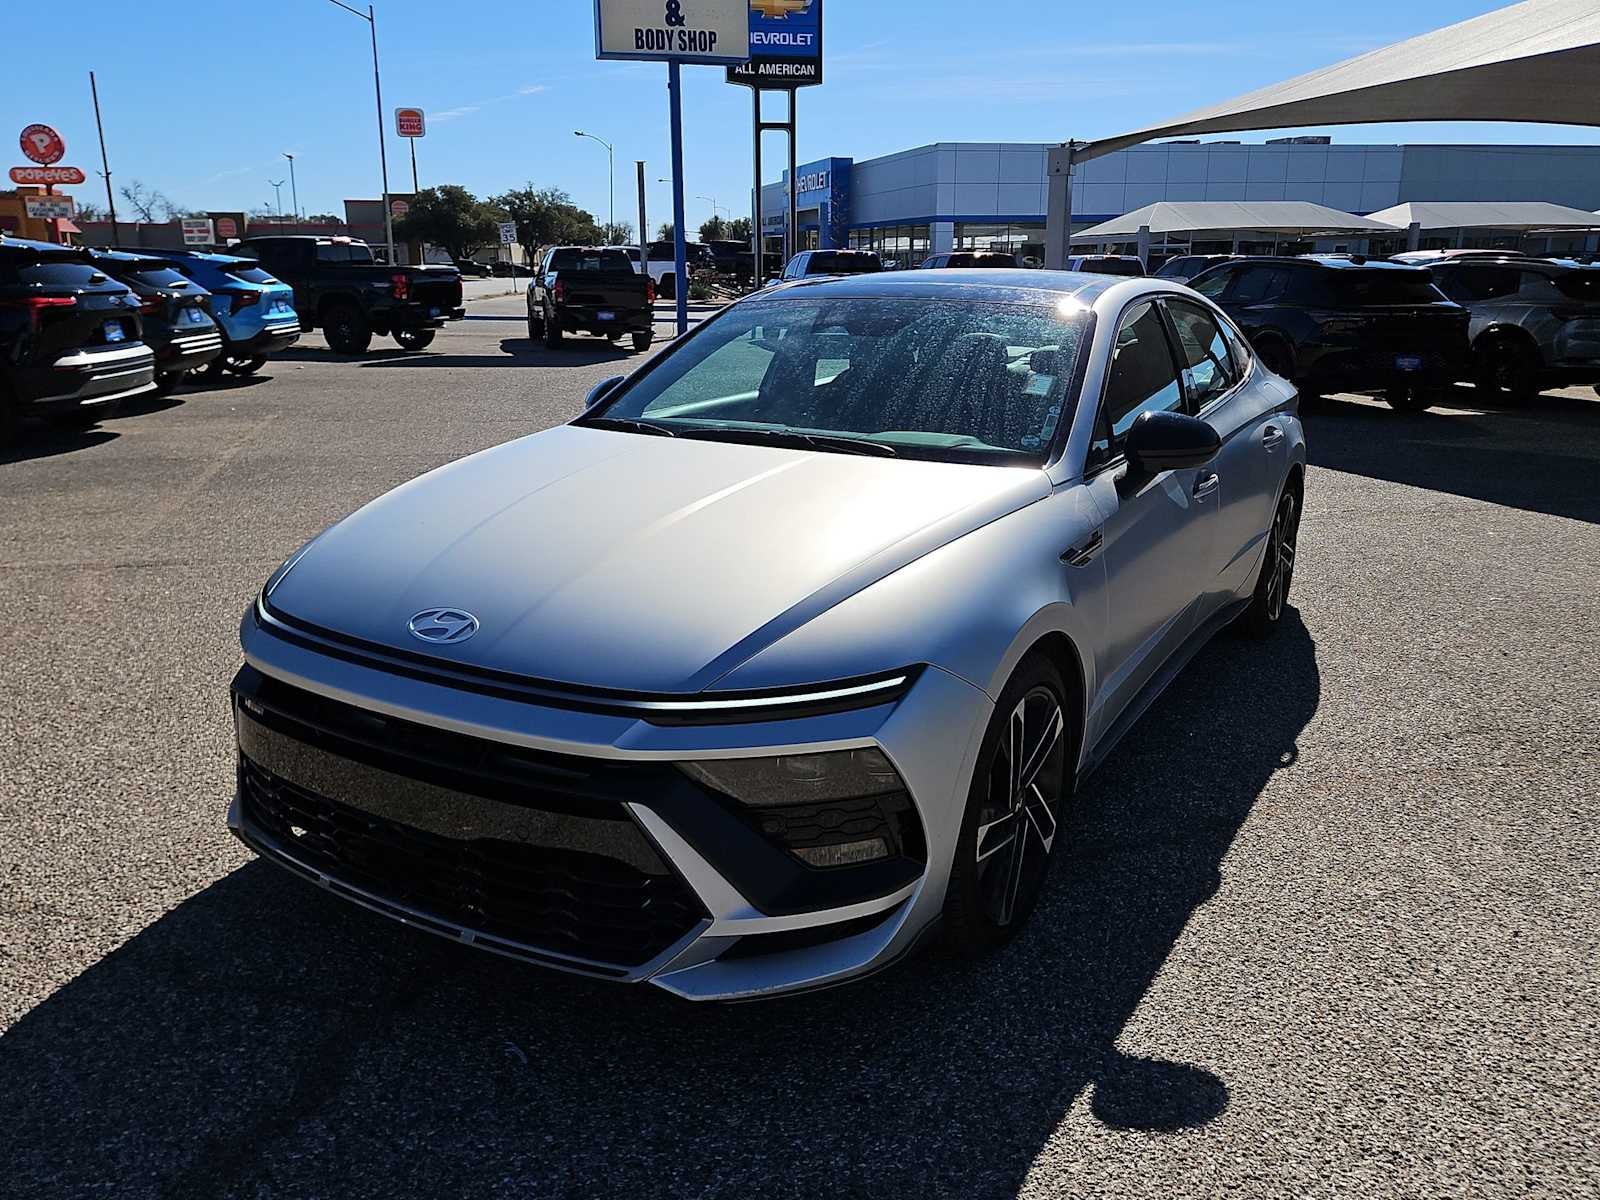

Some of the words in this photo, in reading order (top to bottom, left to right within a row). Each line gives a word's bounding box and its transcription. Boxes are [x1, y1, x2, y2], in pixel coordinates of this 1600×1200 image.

[665, 0, 686, 26] &
[634, 28, 674, 50] BODY
[678, 30, 717, 52] SHOP
[758, 63, 815, 76] AMERICAN
[399, 123, 421, 131] KING
[502, 233, 516, 242] 35
